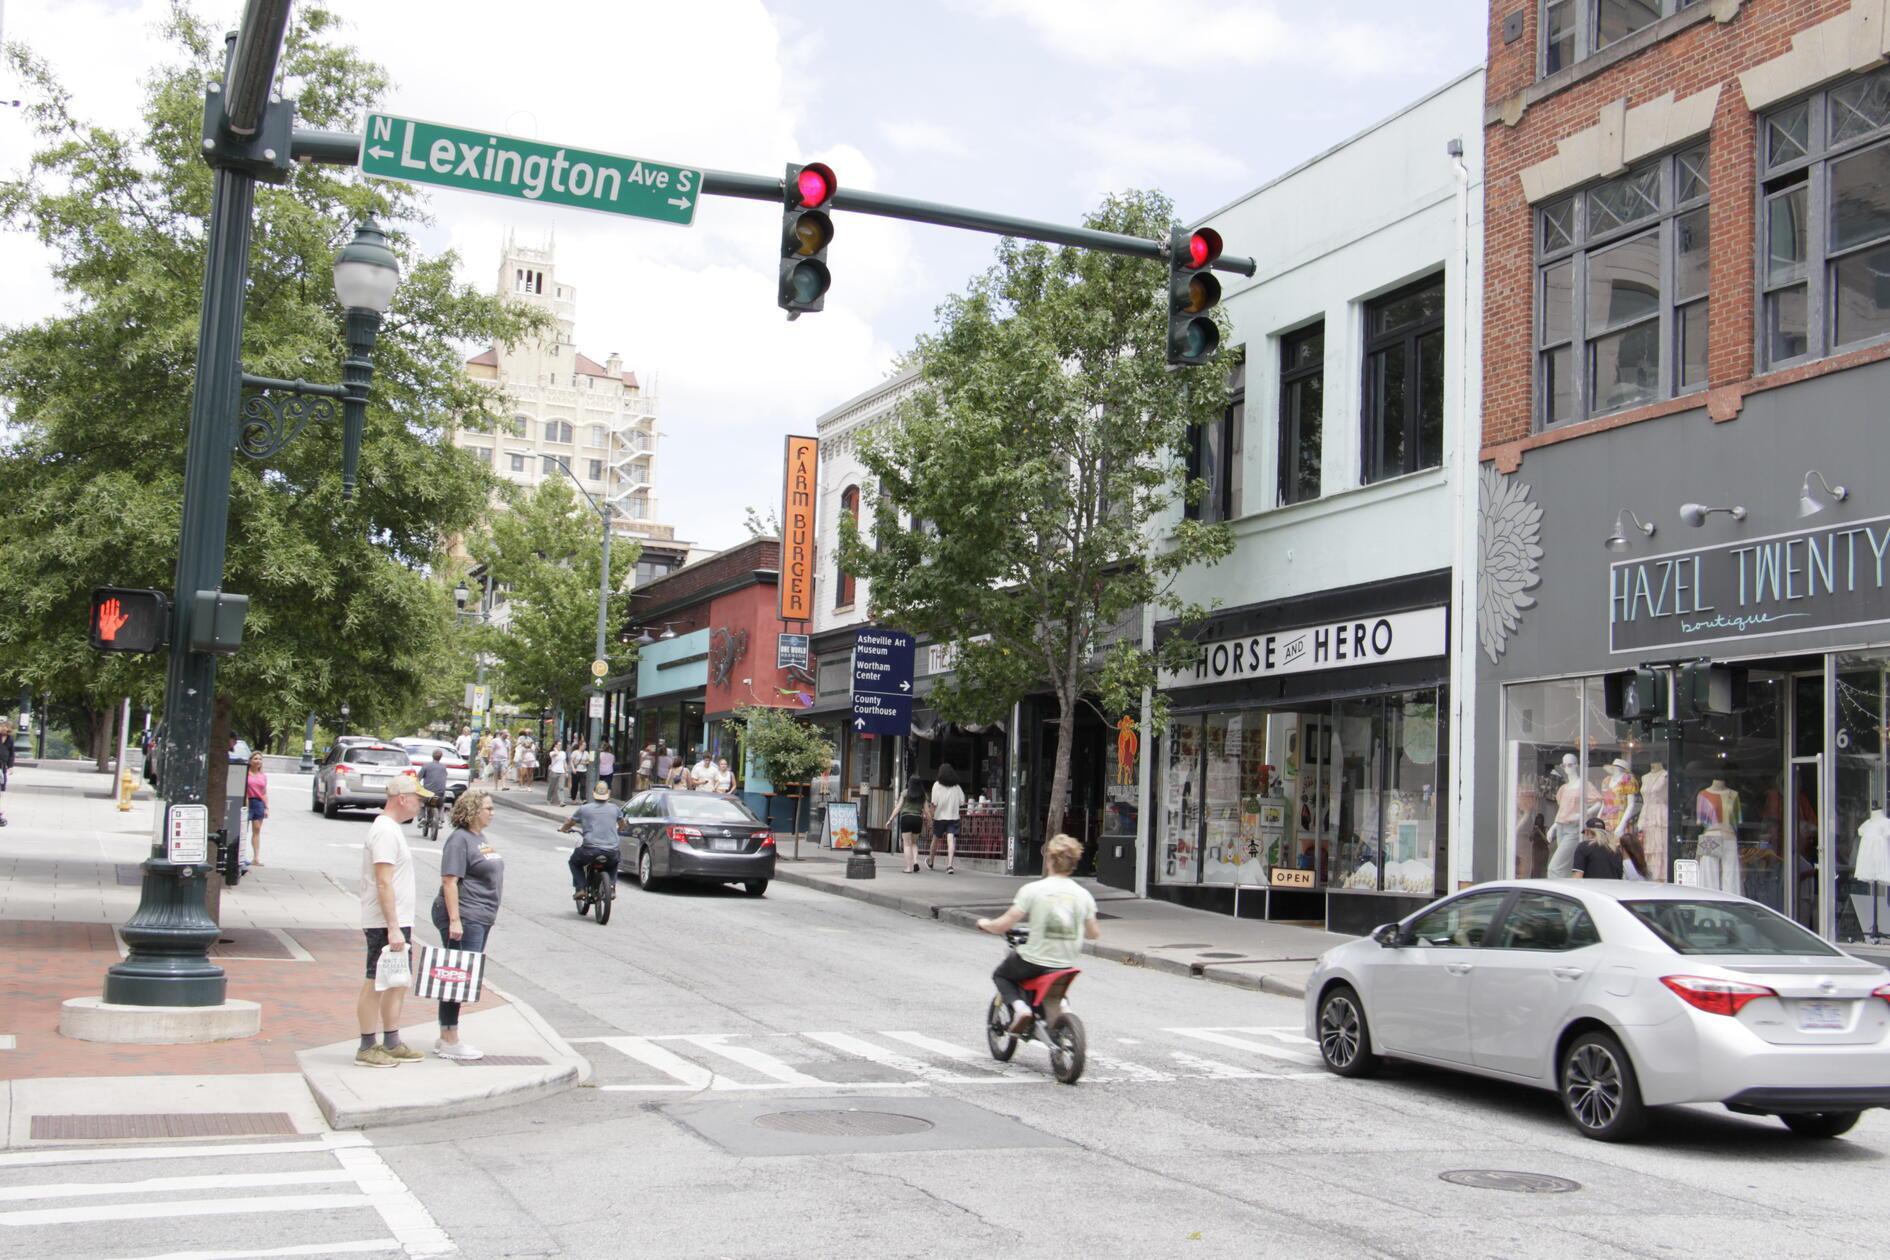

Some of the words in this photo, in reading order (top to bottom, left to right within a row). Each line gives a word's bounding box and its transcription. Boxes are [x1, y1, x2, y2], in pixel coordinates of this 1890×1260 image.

[373, 117, 393, 142] N
[400, 121, 622, 200] Lexington
[627, 161, 670, 189] Ave
[675, 170, 694, 192] S
[792, 446, 809, 507] FARM
[790, 513, 807, 611] BURGER
[1612, 555, 1715, 624] HAZEL
[1730, 527, 1890, 607] TWENTY
[1680, 612, 1812, 633] boutique
[857, 635, 892, 646] Asheville
[894, 637, 906, 648] Art
[857, 644, 888, 656] Museum
[1195, 636, 1277, 679] HORSE
[1284, 640, 1304, 661] AND
[1314, 618, 1393, 664] HERO
[856, 660, 891, 672] Wortham
[856, 671, 881, 681] Center
[854, 694, 881, 706] County
[854, 704, 897, 716] Courthouse
[1836, 728, 1849, 749] 6
[1276, 872, 1311, 883] OPEN
